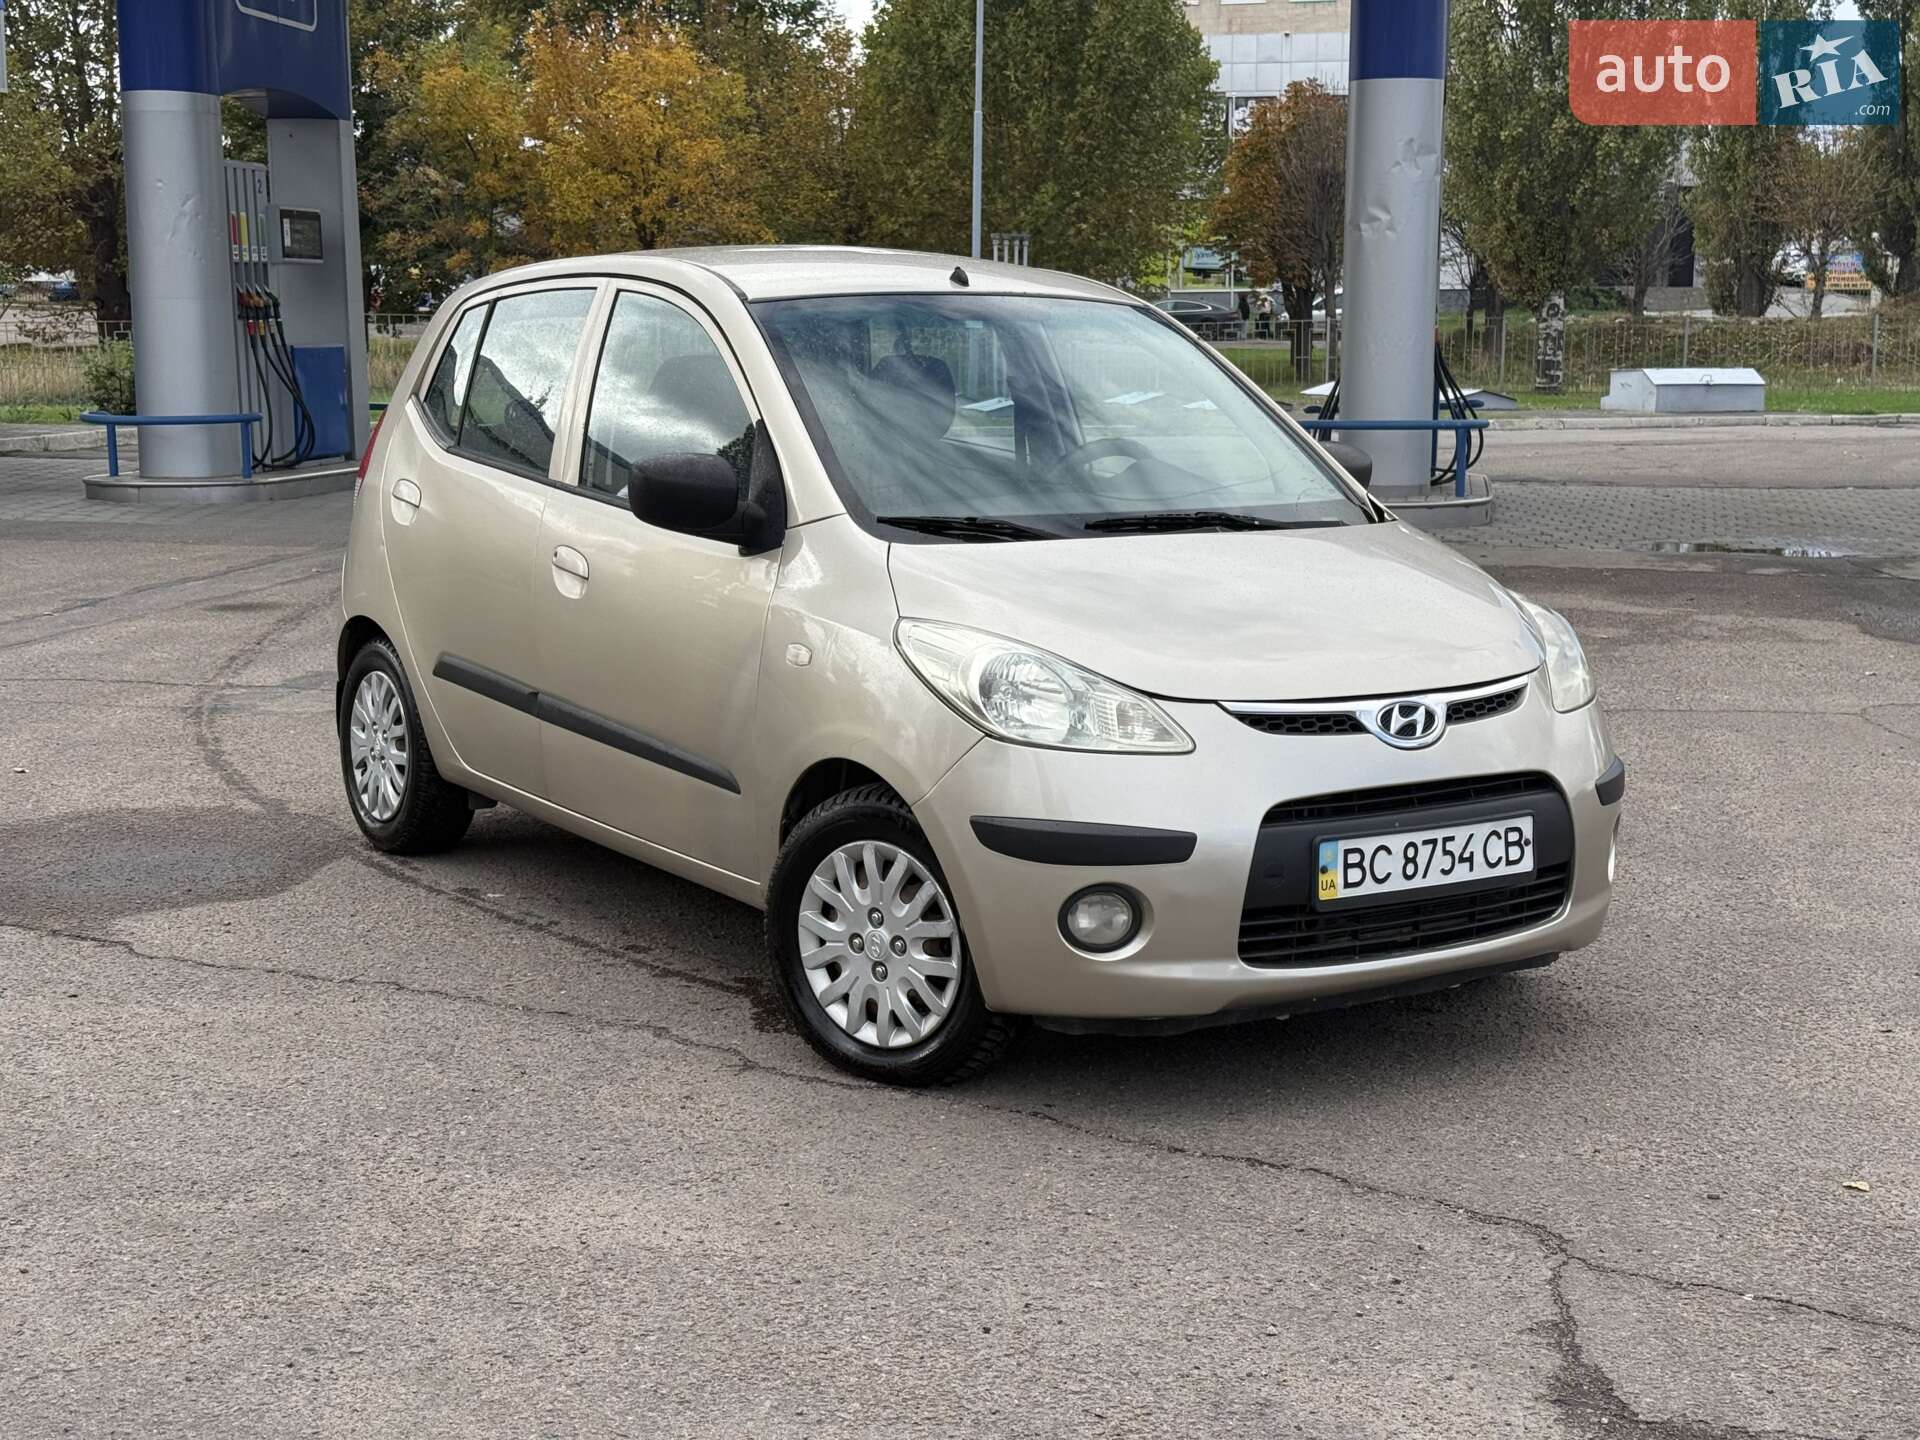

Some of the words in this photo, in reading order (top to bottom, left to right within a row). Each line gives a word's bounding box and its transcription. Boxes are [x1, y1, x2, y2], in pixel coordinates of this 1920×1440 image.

[1343, 844, 1393, 889] BC
[1402, 833, 1475, 881] 8754
[1483, 826, 1525, 869] CB
[1320, 878, 1337, 891] UA
